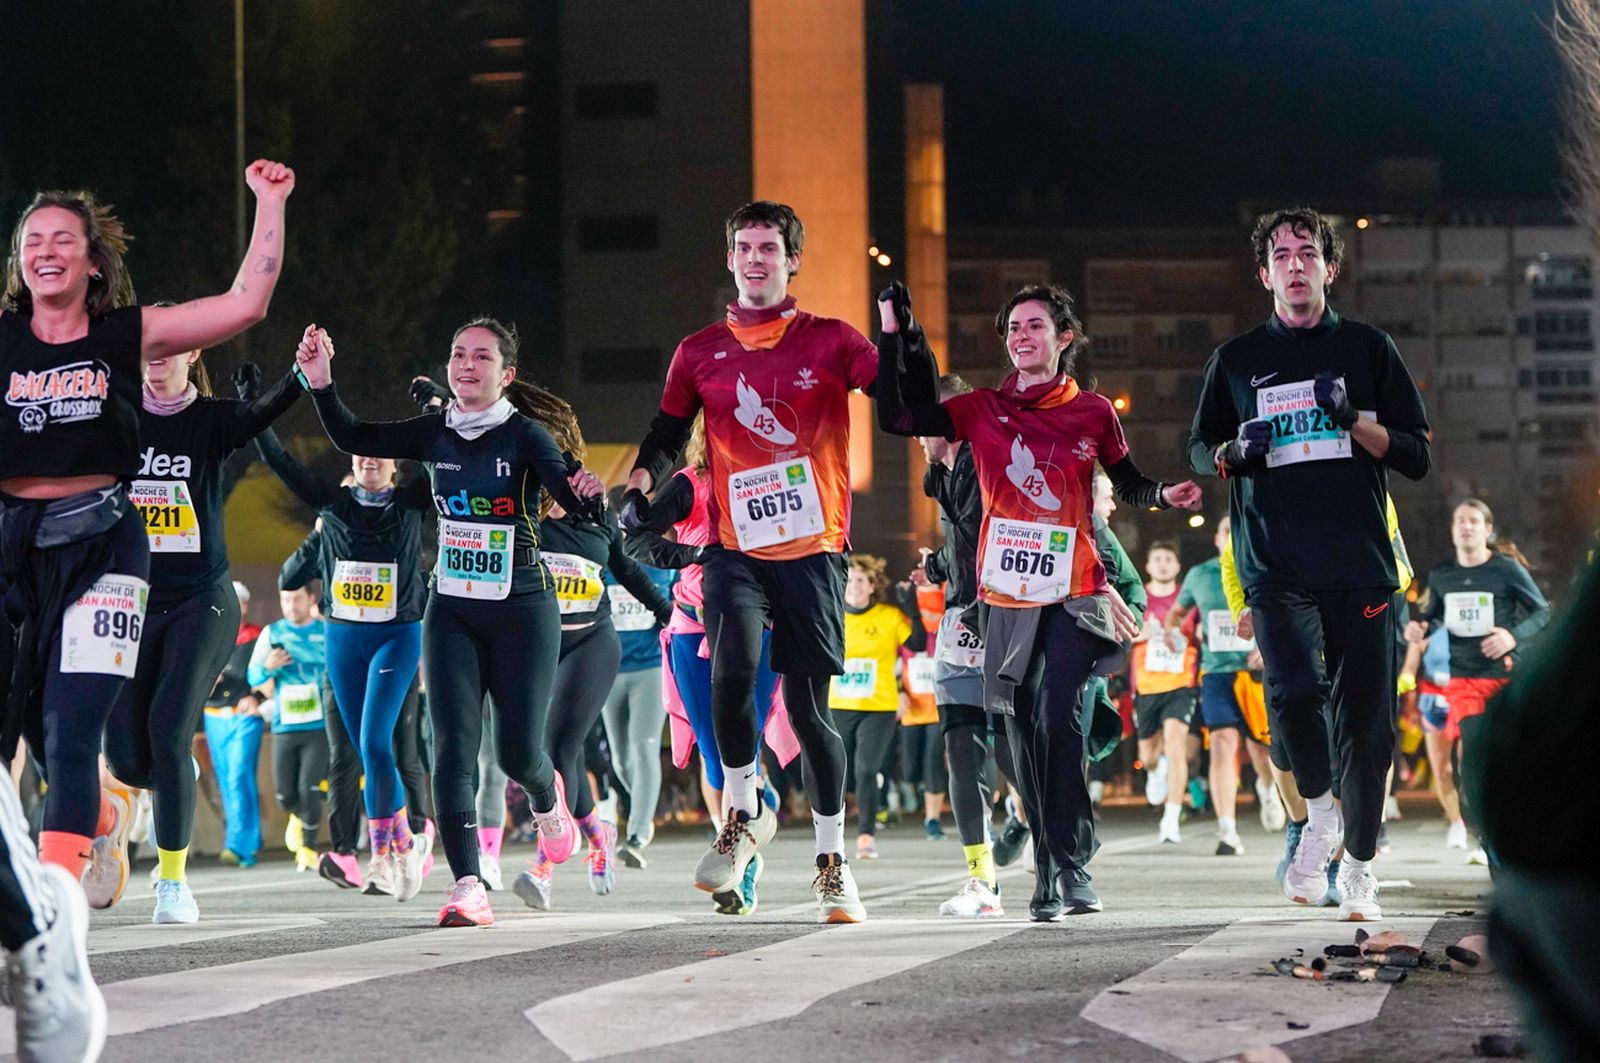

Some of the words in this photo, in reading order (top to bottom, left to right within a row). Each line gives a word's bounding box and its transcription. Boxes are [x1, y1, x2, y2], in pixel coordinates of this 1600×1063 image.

[9, 368, 109, 401] BALACERA
[1276, 391, 1300, 402] NOCHE
[1302, 390, 1313, 399] DE
[50, 400, 102, 417] CROSSBOX
[1267, 405, 1284, 415] SAN
[753, 414, 775, 435] 43
[743, 476, 768, 488] NOCHE
[769, 473, 779, 482] DE
[1022, 475, 1045, 497] 43
[134, 487, 157, 496] NOCHE
[736, 488, 753, 500] SAN
[747, 488, 803, 521] 6675
[451, 530, 471, 539] NOCHE
[473, 531, 482, 540] DE
[996, 536, 1012, 546] SAN
[1006, 528, 1031, 539] NOCHE
[1032, 531, 1042, 540] DE
[446, 537, 456, 546] SAN
[446, 547, 503, 574] 13698
[1000, 548, 1055, 577] 6676
[89, 584, 122, 596] NOCHE
[124, 587, 135, 598] DE
[342, 582, 385, 602] 3982
[77, 596, 98, 607] SAN
[1459, 609, 1480, 621] 931
[93, 609, 141, 643] 896
[957, 632, 984, 649] 33
